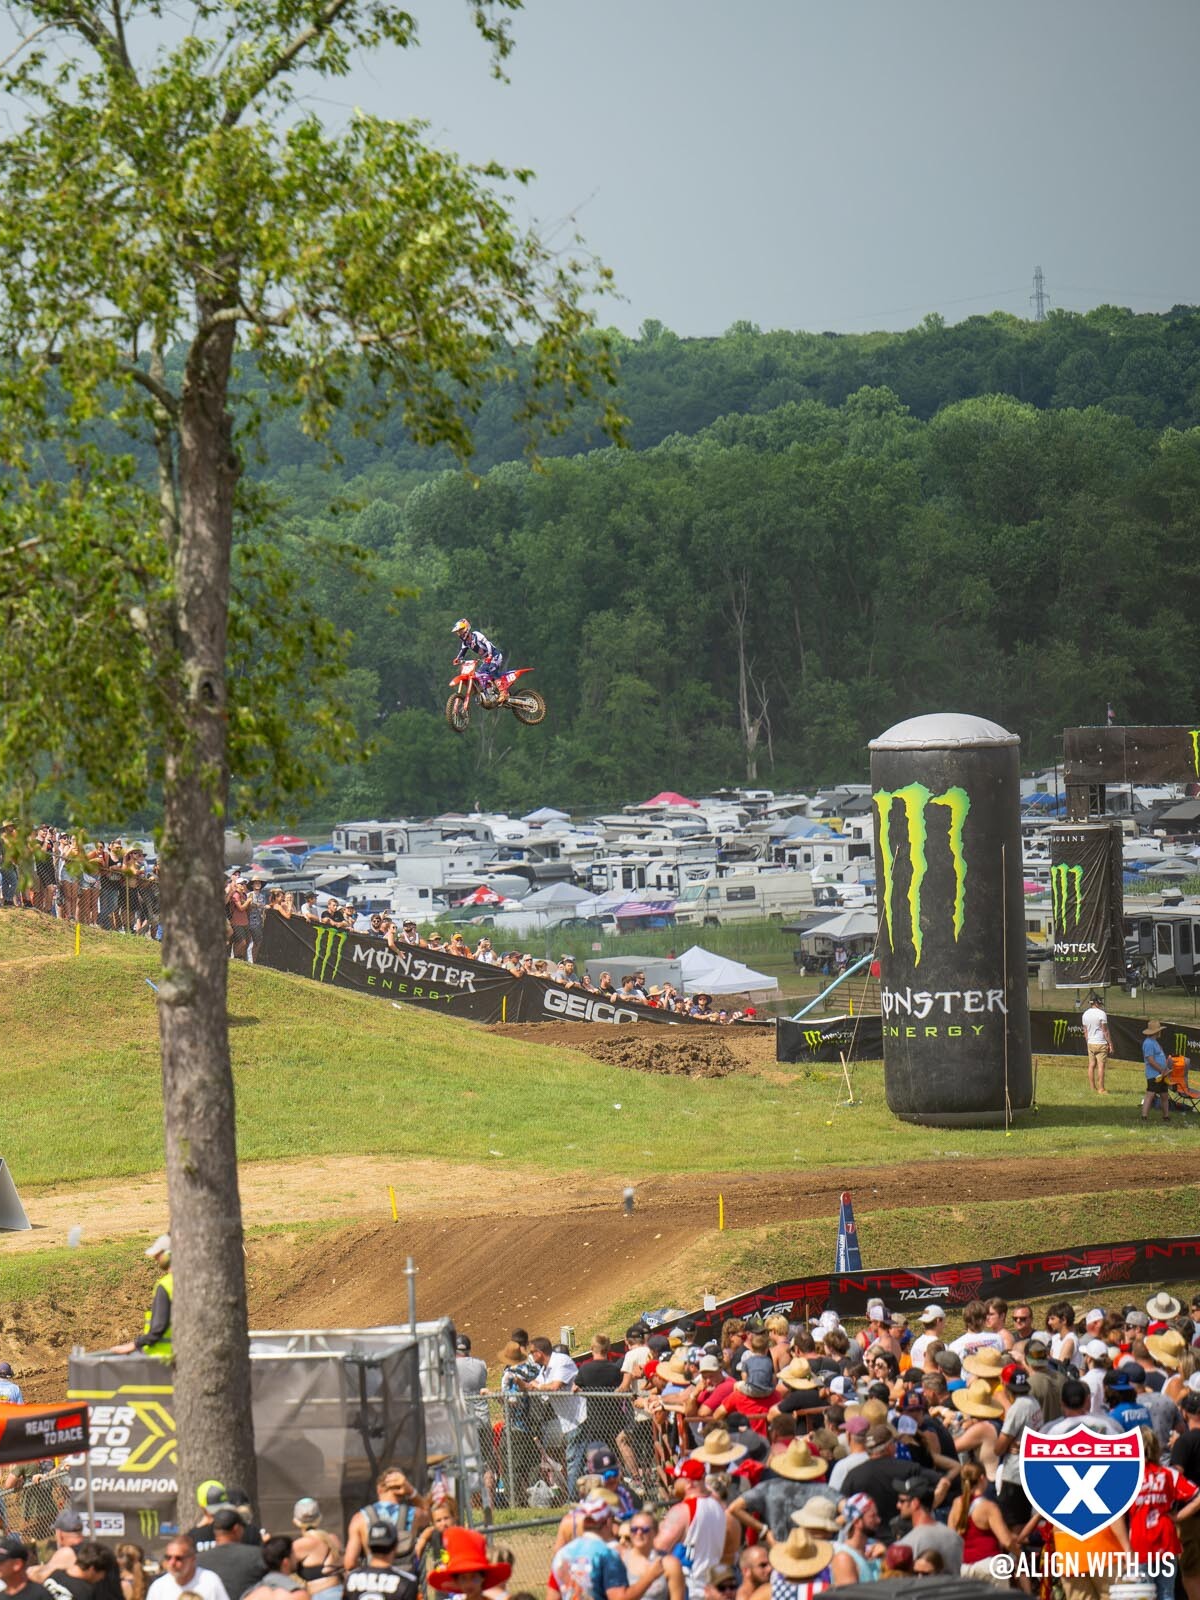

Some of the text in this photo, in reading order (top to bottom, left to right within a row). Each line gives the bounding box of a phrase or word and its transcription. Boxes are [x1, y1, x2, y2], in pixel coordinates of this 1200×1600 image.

[352, 944, 476, 993] MONSTER
[367, 975, 455, 1003] ENERGY
[881, 986, 1009, 1020] ONSTER
[991, 1246, 1137, 1279] INTENSE
[1050, 1265, 1101, 1283] TAZER
[840, 1267, 983, 1294] INTENSE
[900, 1286, 950, 1301] TAZER
[25, 1419, 57, 1436] READY
[44, 1426, 83, 1445] TO RACE
